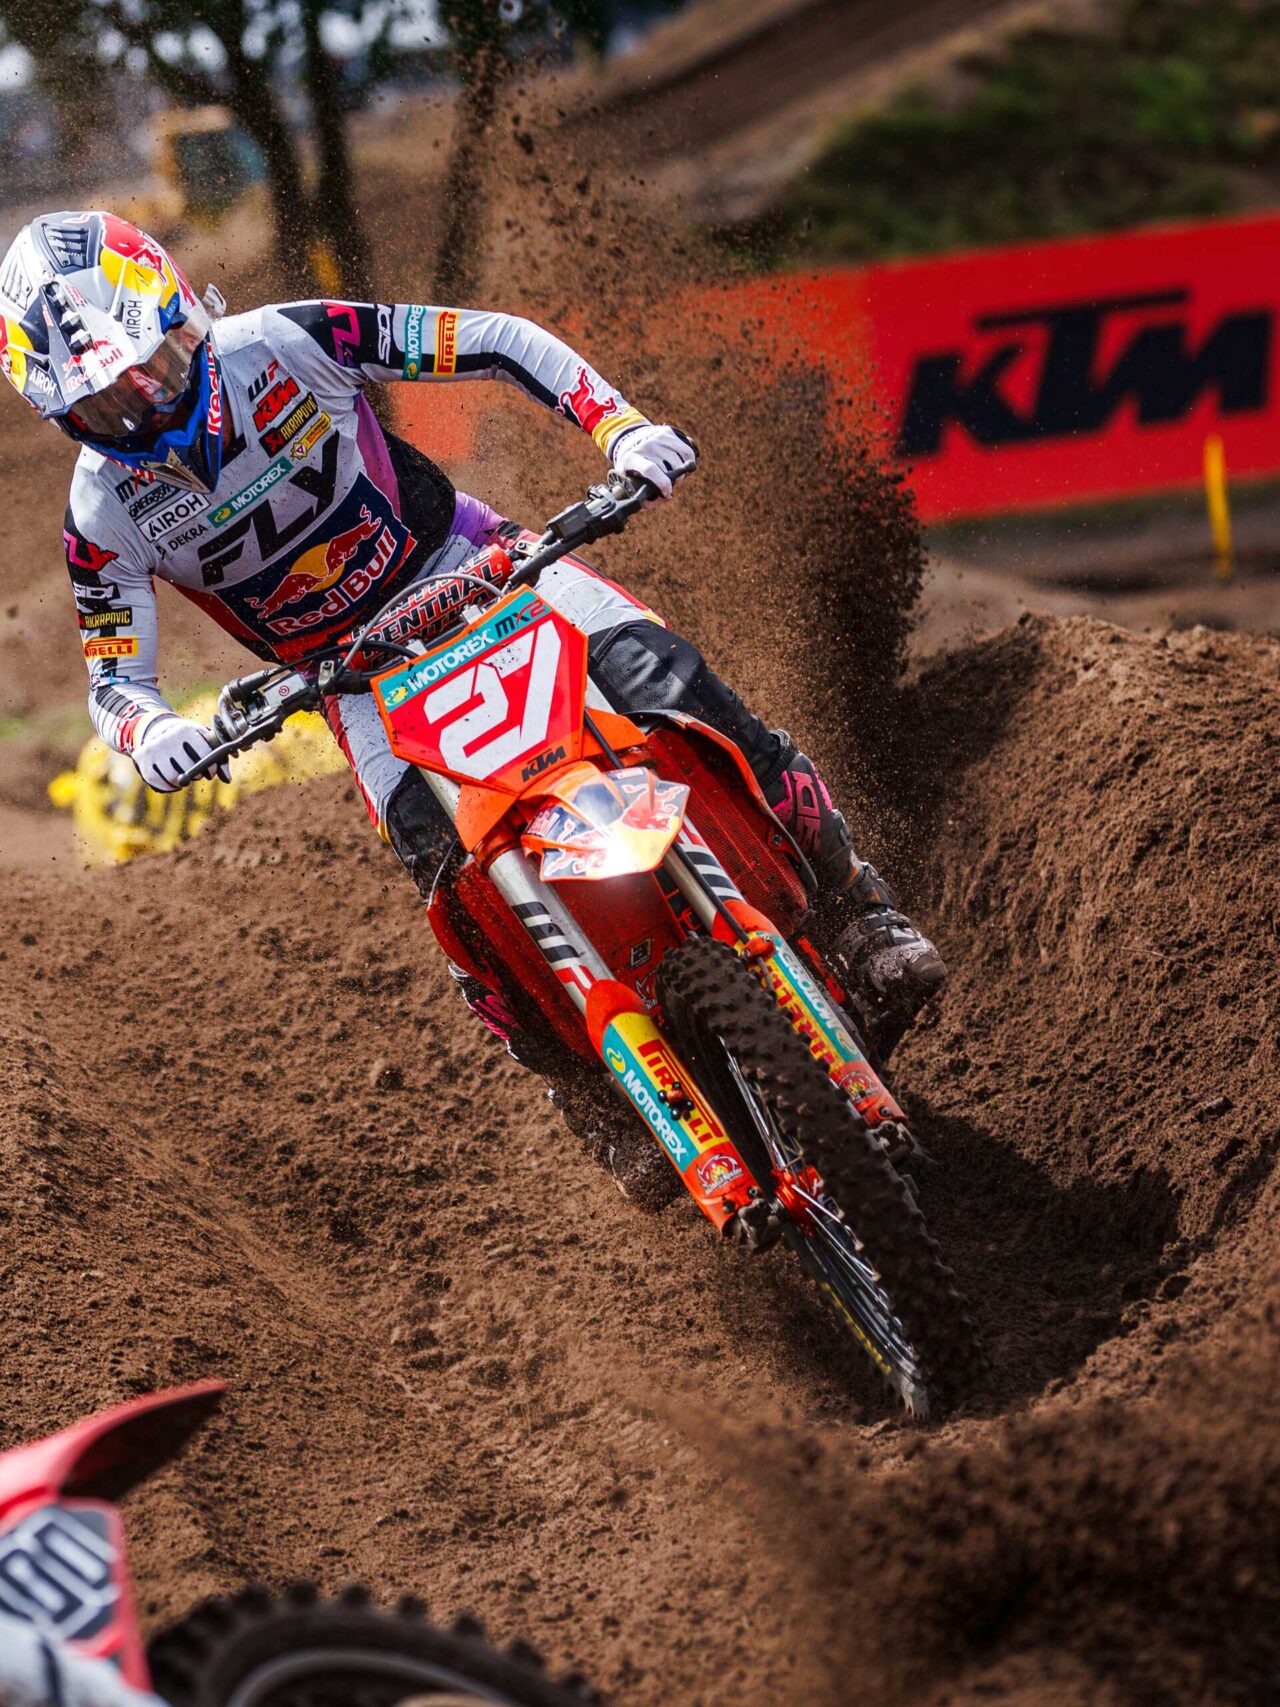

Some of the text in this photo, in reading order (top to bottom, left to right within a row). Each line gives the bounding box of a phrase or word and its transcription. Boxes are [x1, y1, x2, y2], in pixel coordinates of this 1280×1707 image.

[127, 299, 143, 339] AIROH
[408, 304, 424, 359] MOTORE
[436, 312, 457, 373] PIRELLI
[28, 365, 58, 398] AIROH
[898, 288, 1274, 458] KTM
[252, 376, 302, 432] KTM
[147, 494, 204, 537] AIROH
[197, 429, 340, 587] FLY
[230, 462, 288, 511] MOTOREX
[168, 523, 210, 551] DEKRA
[266, 588, 350, 636] Red
[339, 525, 398, 601] Bull
[406, 629, 496, 693] MOTOREX
[494, 599, 550, 638] MX2
[423, 618, 562, 781] 27
[521, 745, 567, 783] KTM
[622, 1069, 691, 1165] MOTOREX
[637, 1038, 724, 1145] PIRLI
